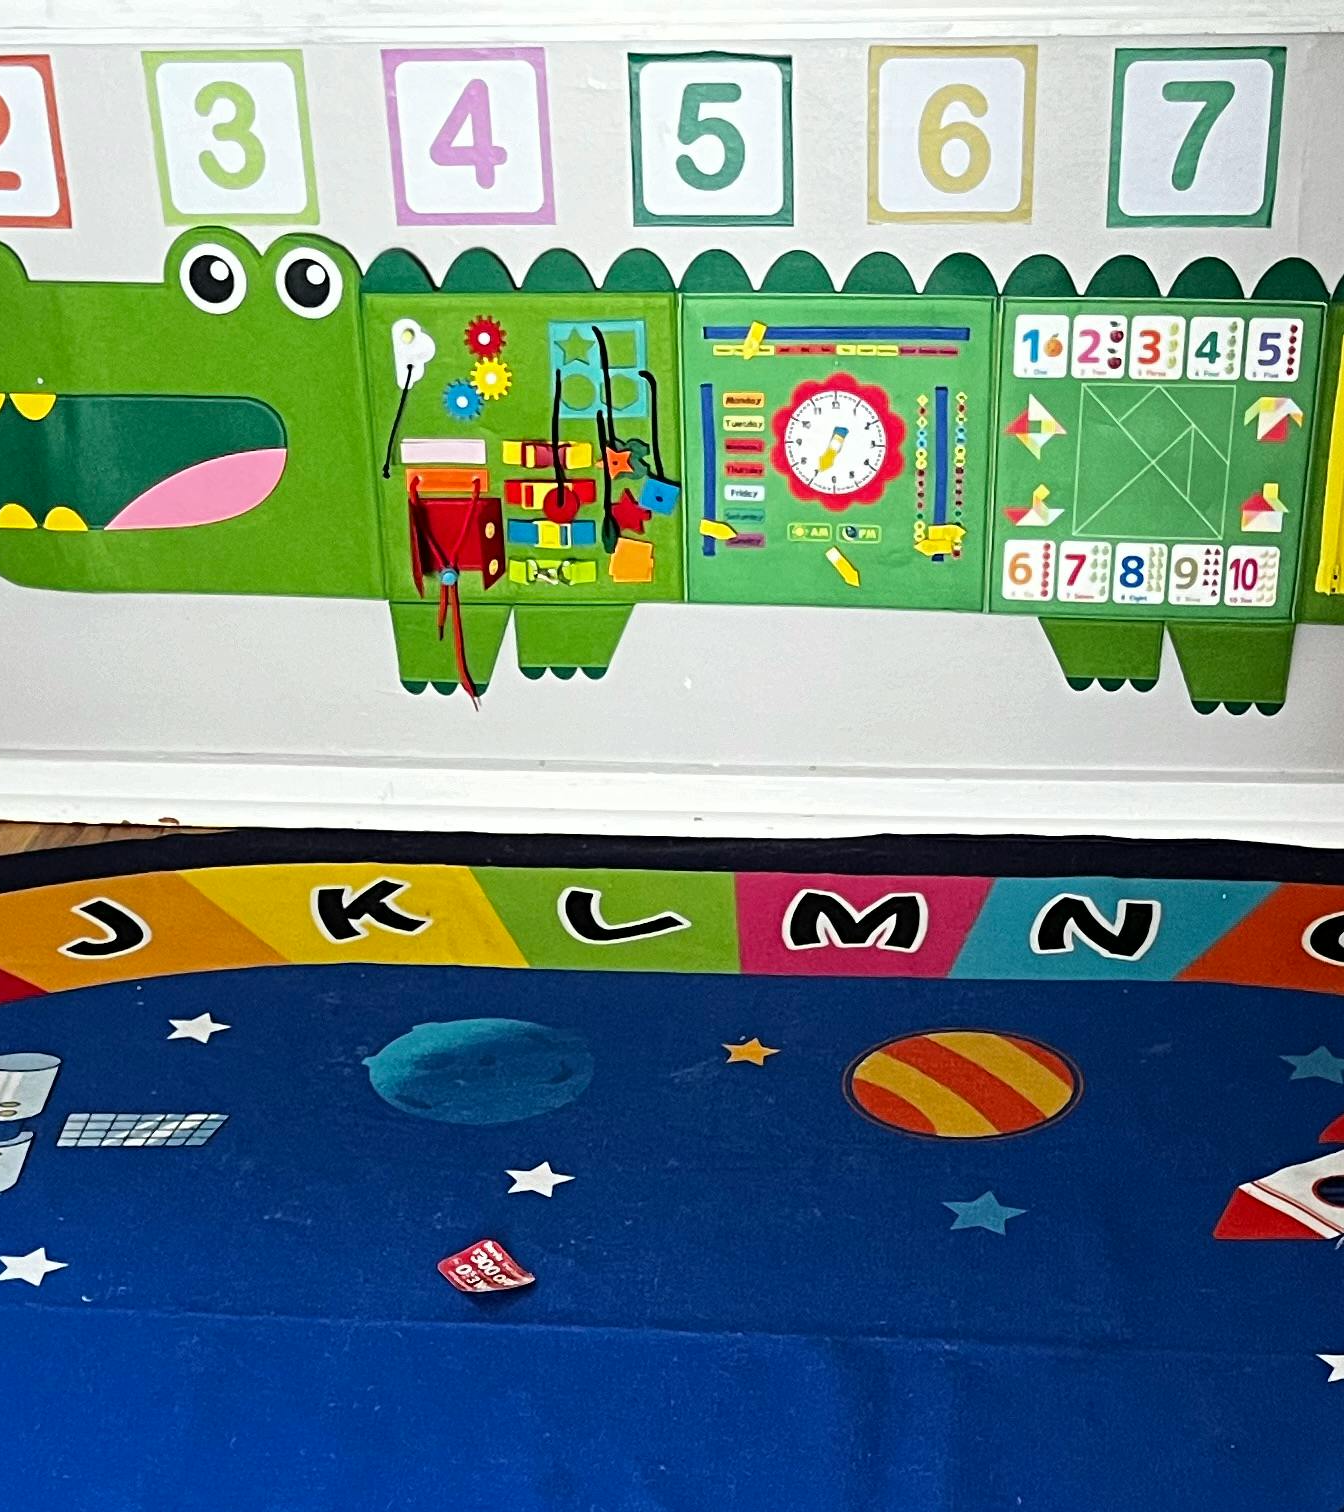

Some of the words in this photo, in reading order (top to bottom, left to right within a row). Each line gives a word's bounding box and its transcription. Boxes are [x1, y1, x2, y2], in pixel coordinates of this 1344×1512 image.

[193, 81, 266, 191] 3
[428, 79, 507, 189] 4
[674, 81, 746, 193] 5
[918, 82, 992, 194] 6
[1161, 80, 1236, 192] 7
[1022, 329, 1040, 363] 1
[1077, 329, 1101, 363] 2
[1137, 330, 1161, 364] 3
[1194, 331, 1221, 364] 4
[1257, 332, 1282, 366] 5
[725, 396, 762, 406] Monday
[810, 527, 829, 538] AM
[858, 528, 878, 540] PM
[1008, 551, 1033, 585] 6
[1065, 554, 1087, 586] 7
[1119, 555, 1145, 588] 8
[1174, 557, 1198, 589] 9
[1229, 558, 1258, 590] 10
[309, 880, 430, 942] K
[556, 888, 693, 944] L
[782, 889, 928, 953] M
[1029, 893, 1163, 960] N
[58, 898, 151, 959] J
